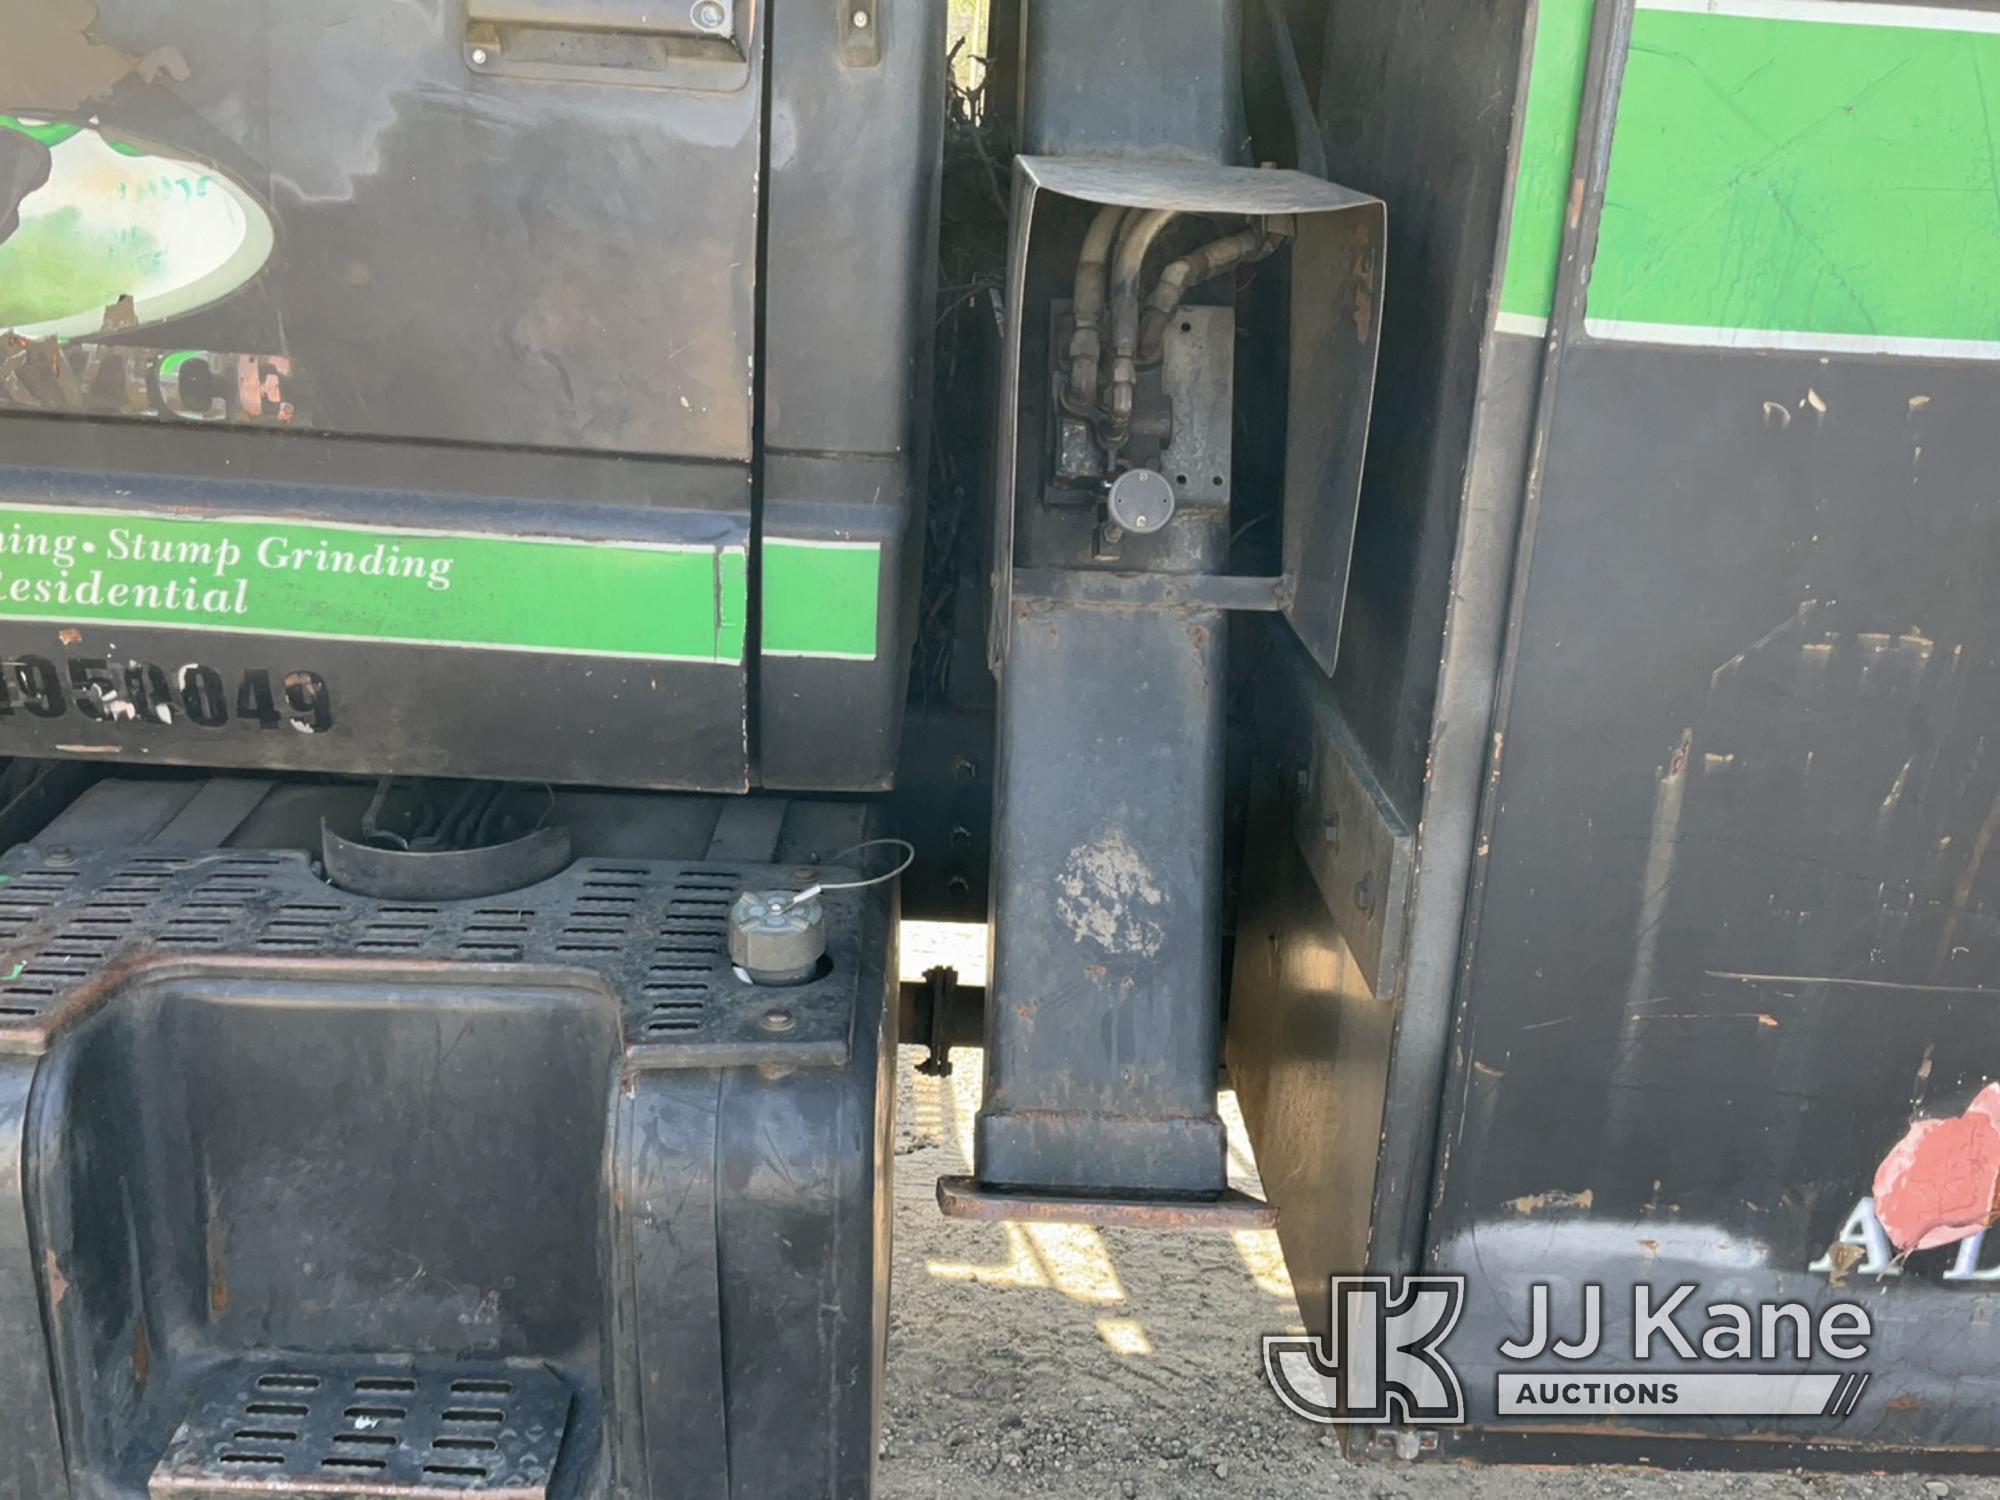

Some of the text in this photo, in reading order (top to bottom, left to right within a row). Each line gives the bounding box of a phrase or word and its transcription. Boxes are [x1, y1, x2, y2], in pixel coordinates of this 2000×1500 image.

[106, 527, 241, 577] Stump
[257, 535, 455, 591] Grinding
[0, 569, 249, 615] esidential
